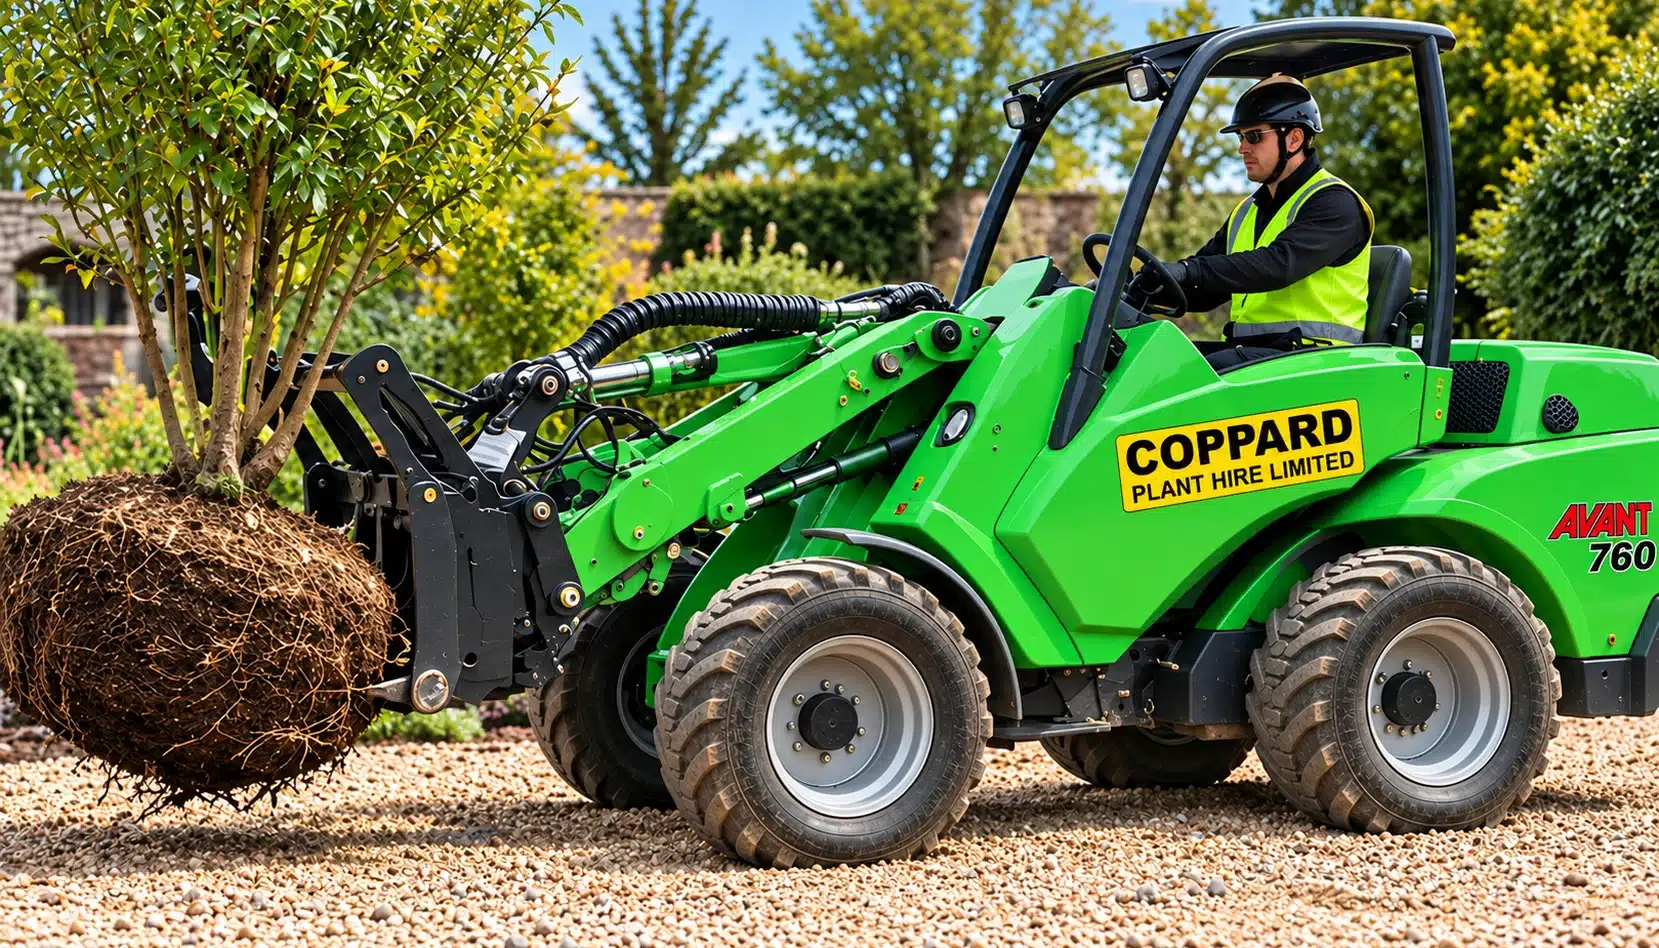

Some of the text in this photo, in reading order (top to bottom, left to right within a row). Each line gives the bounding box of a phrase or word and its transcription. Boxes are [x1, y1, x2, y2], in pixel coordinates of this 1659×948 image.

[1126, 409, 1353, 476] COPPARD
[1132, 450, 1354, 504] PLANT HIRE LIMITED
[1547, 501, 1653, 540] AVANT
[1588, 540, 1657, 573] 760
